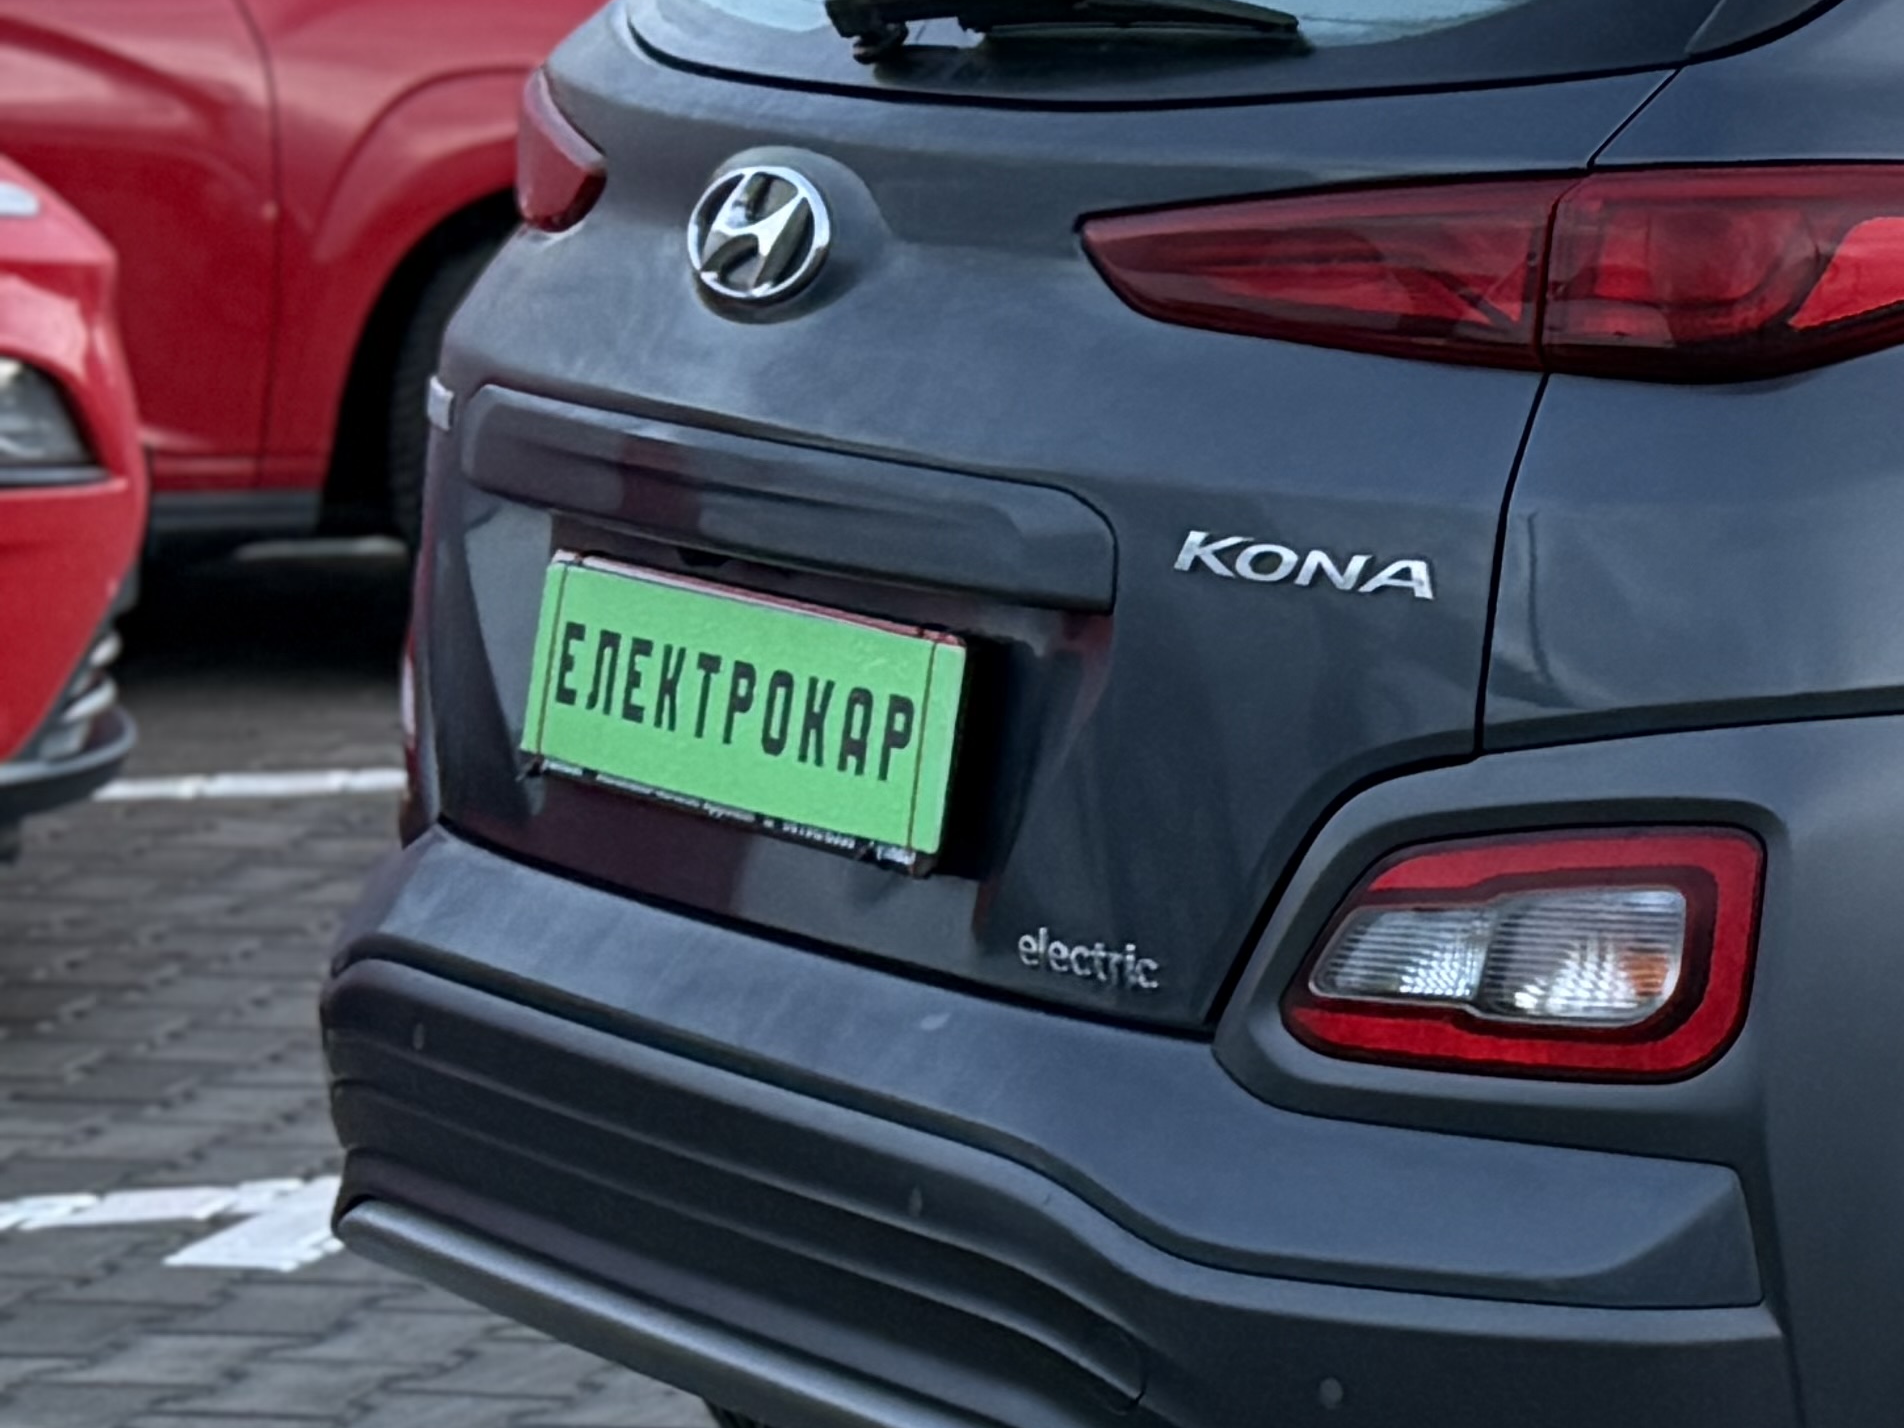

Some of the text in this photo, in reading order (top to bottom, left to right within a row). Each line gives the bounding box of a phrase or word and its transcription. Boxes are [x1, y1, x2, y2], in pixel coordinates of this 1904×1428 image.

[1173, 530, 1434, 600] KONA
[555, 621, 915, 782] ЕЛЕКТРОКАР
[1018, 927, 1160, 989] electric
